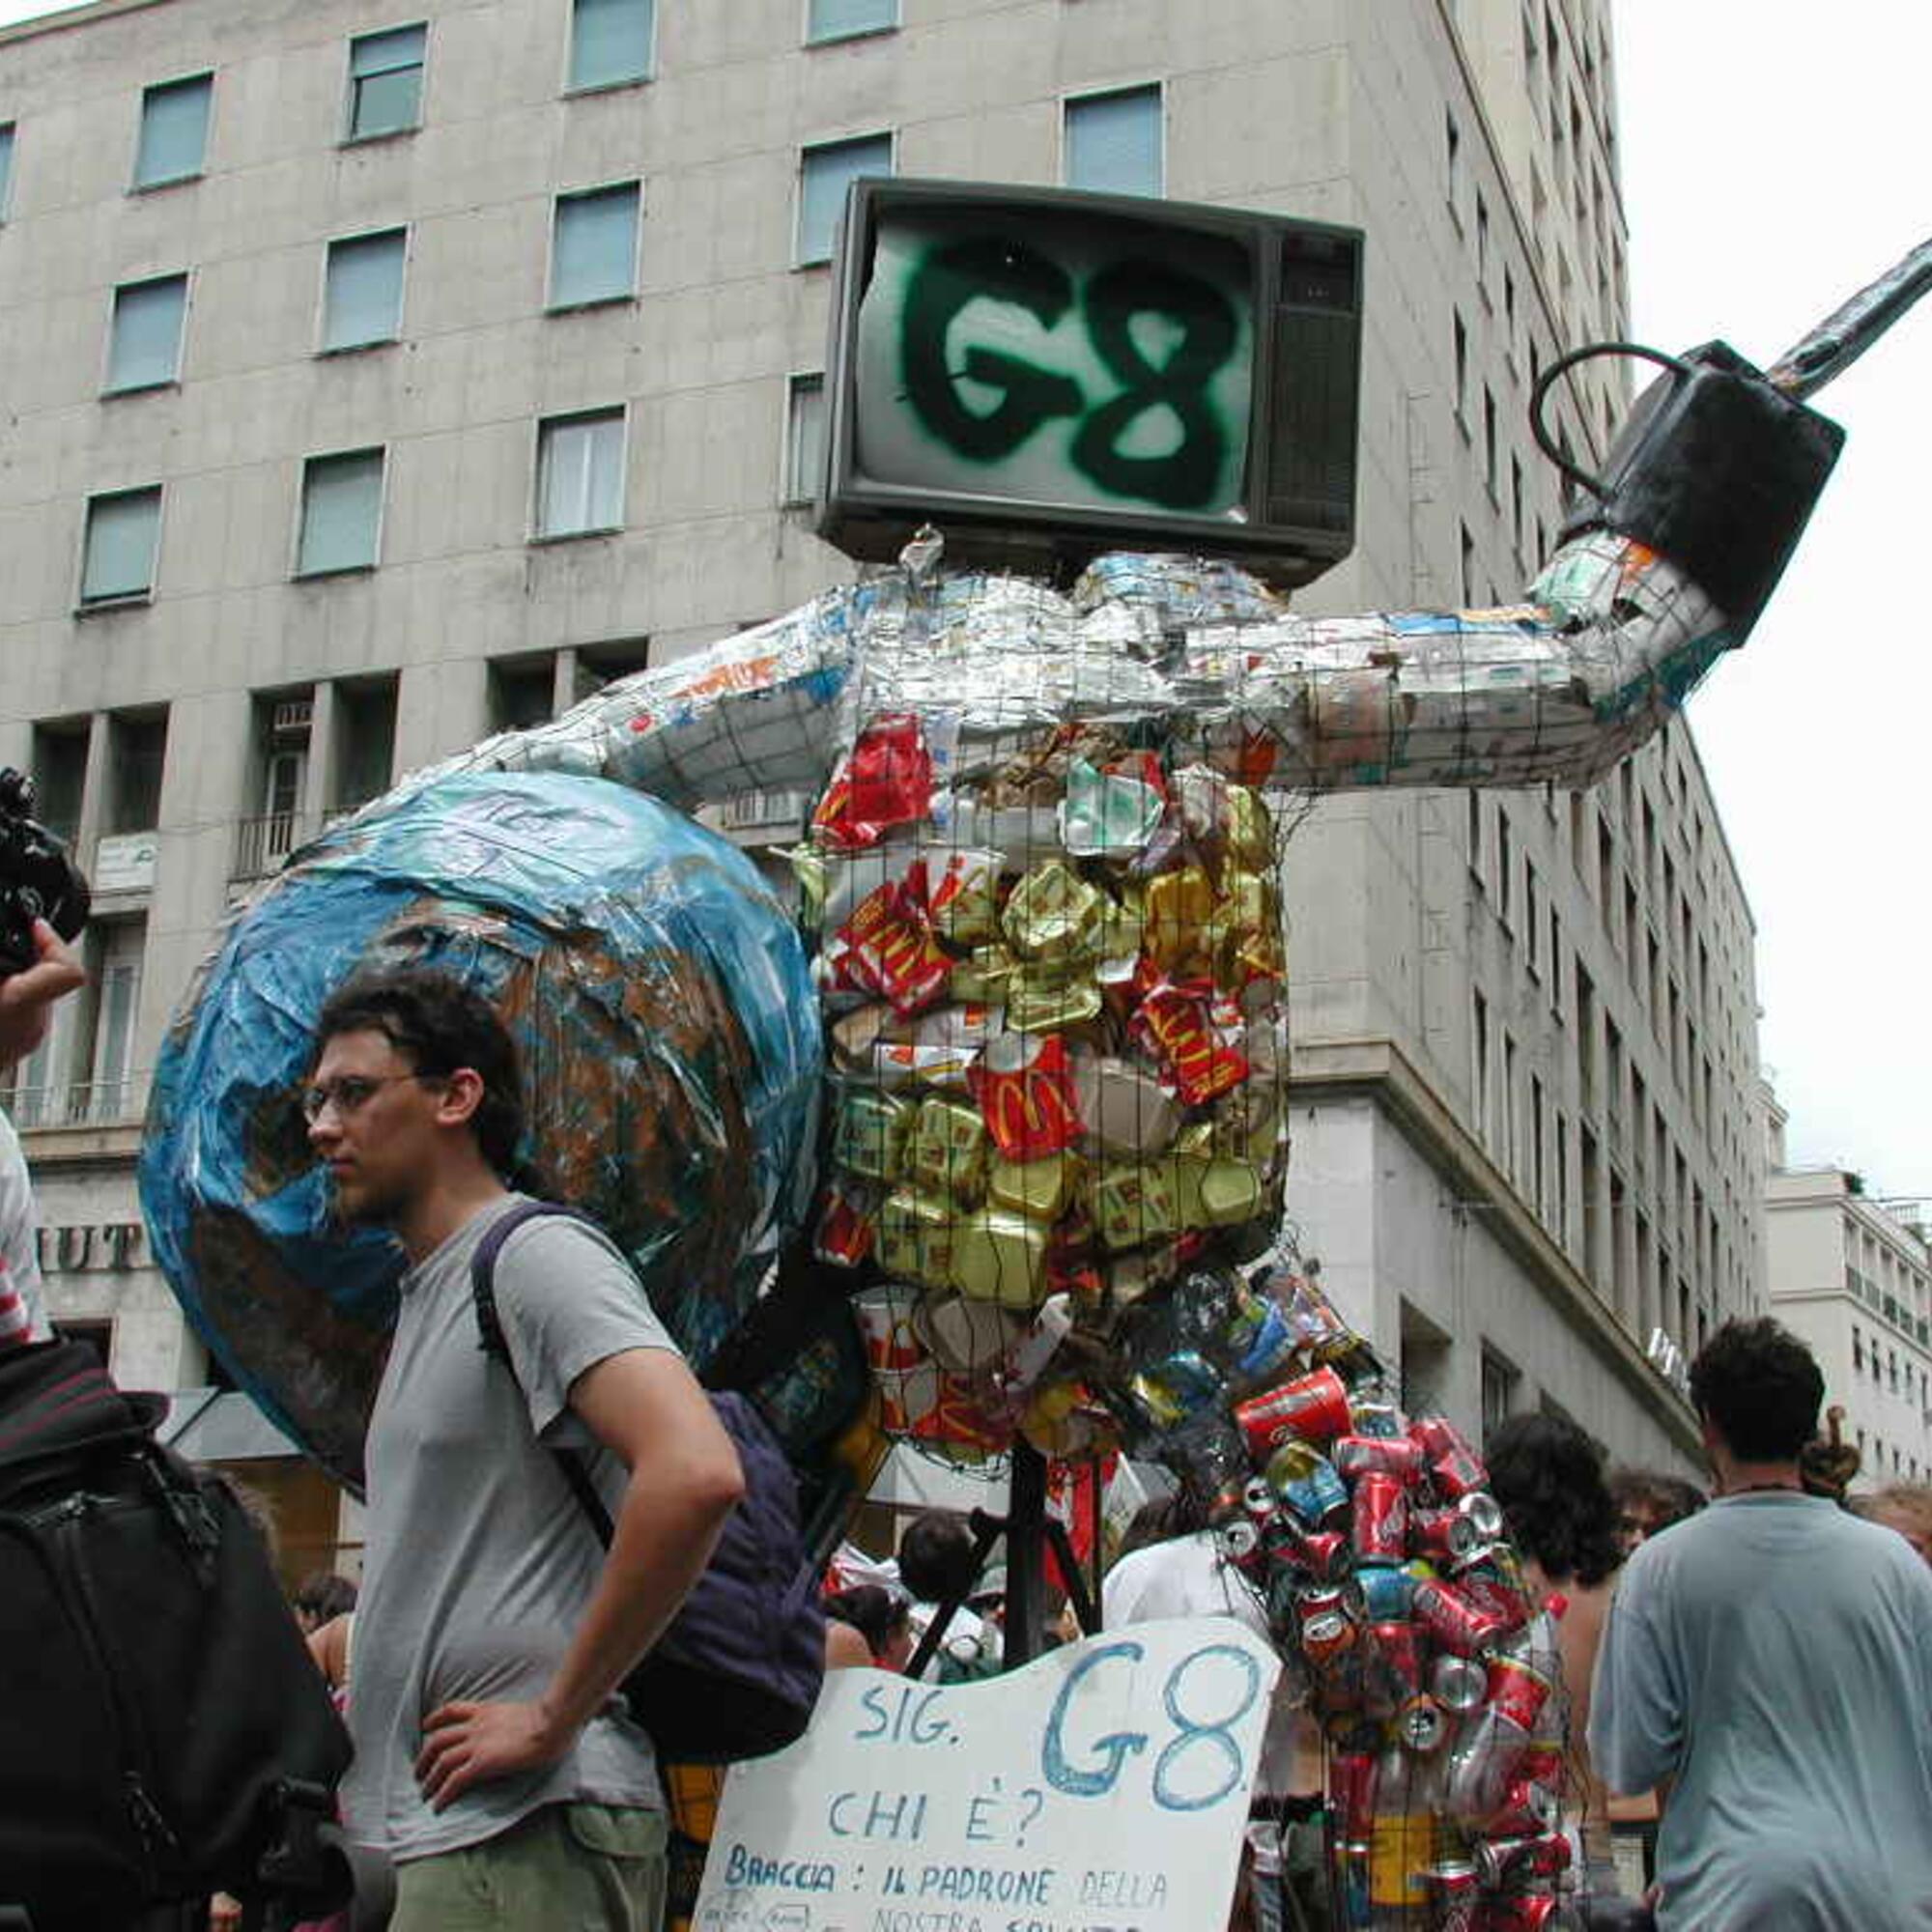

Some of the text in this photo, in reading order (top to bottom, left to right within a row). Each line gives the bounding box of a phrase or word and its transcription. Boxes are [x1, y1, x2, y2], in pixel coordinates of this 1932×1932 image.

[898, 240, 1239, 510] G8
[855, 1641, 1262, 1810] SIG. G8
[828, 1792, 927, 1839] CHI
[918, 1866, 1056, 1908] PADRONE
